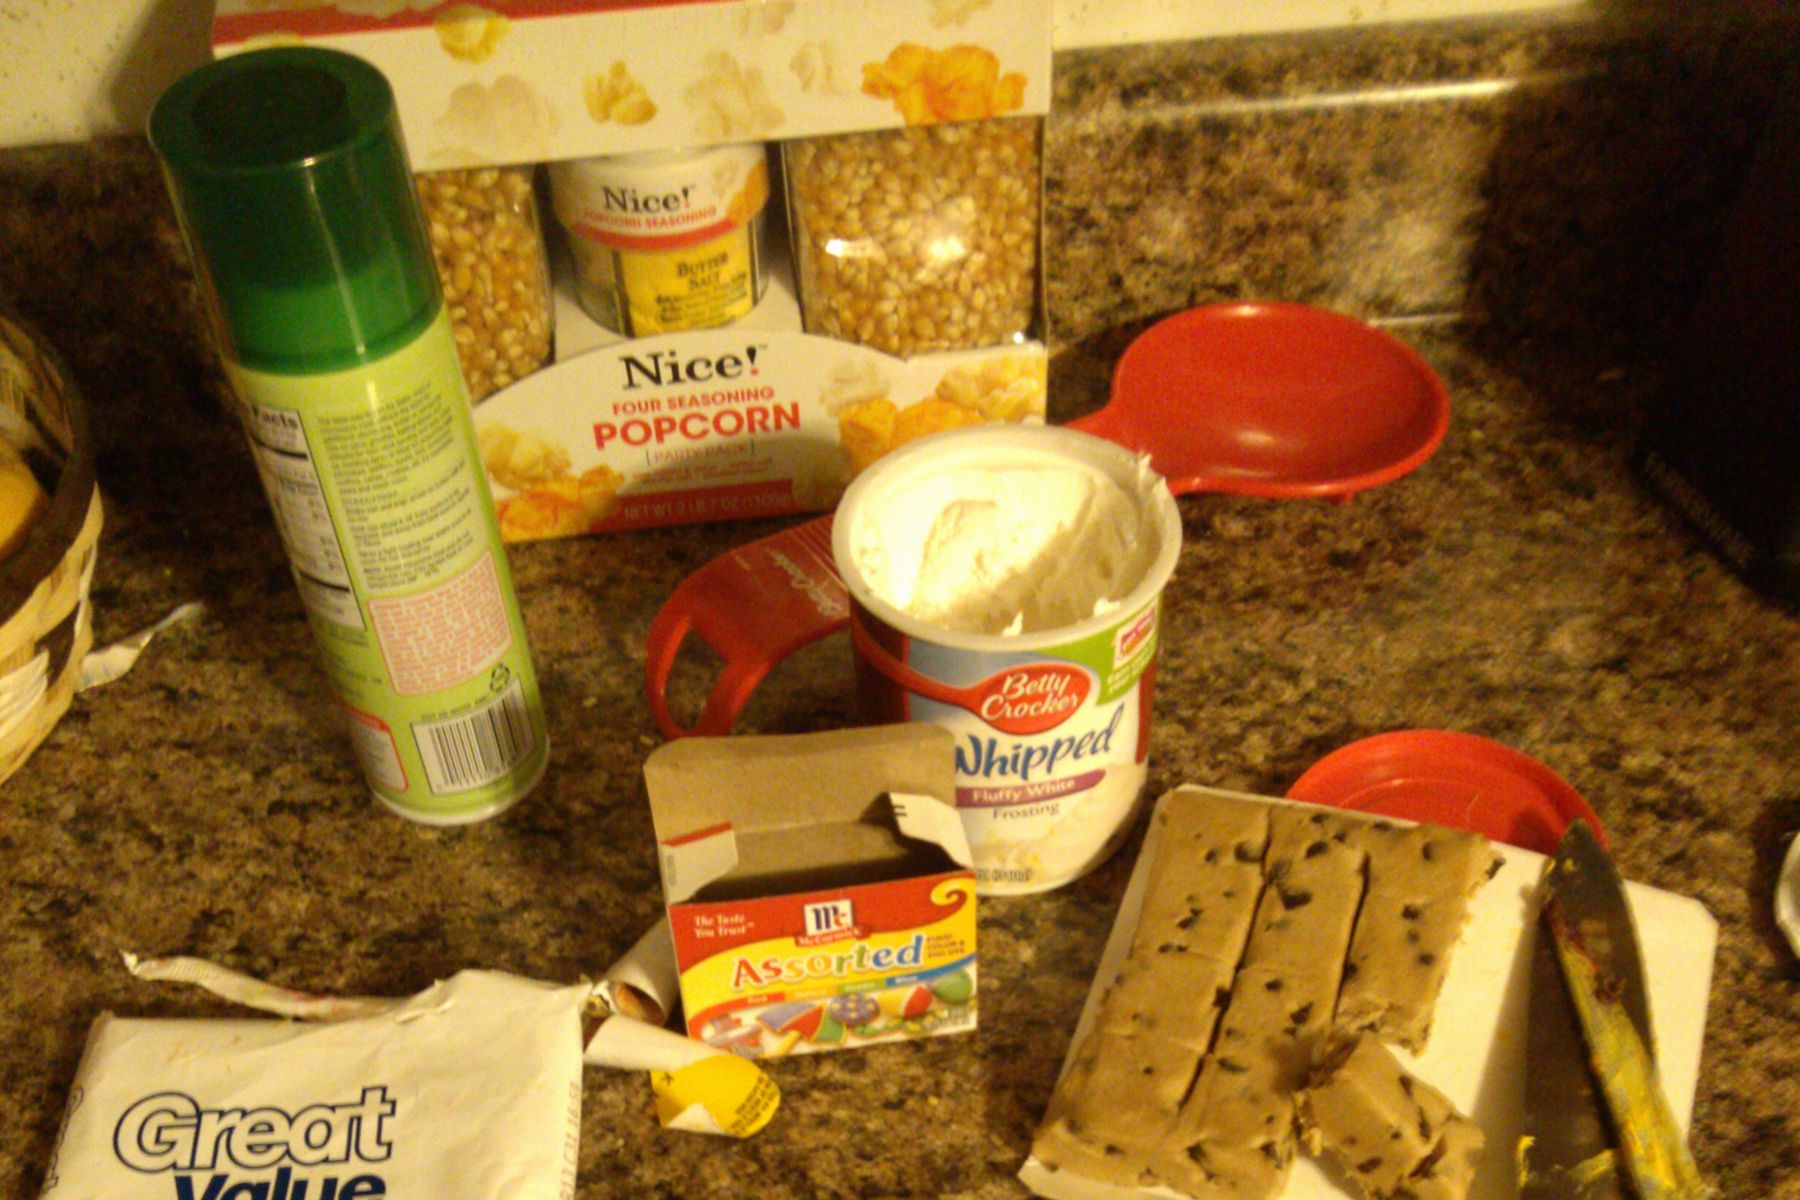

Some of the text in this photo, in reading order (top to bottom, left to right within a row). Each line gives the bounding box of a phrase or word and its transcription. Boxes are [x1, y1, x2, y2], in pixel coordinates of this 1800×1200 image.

[602, 184, 690, 213] Nice!
[646, 205, 717, 228] SEASONING
[619, 345, 760, 390] Nice!
[613, 386, 775, 416] FOUR SEASONING
[592, 401, 801, 452] POPCORN
[1002, 671, 1072, 699] Betty
[981, 690, 1079, 720] Crocker
[955, 703, 1124, 781] Whipped
[973, 776, 1076, 802] Fluffy White
[992, 801, 1060, 820] Frosting
[695, 913, 745, 928] The Taste
[695, 924, 746, 939] You Trust
[798, 928, 862, 946] McCormick
[732, 934, 924, 990] Assorted
[113, 1085, 397, 1174] Great
